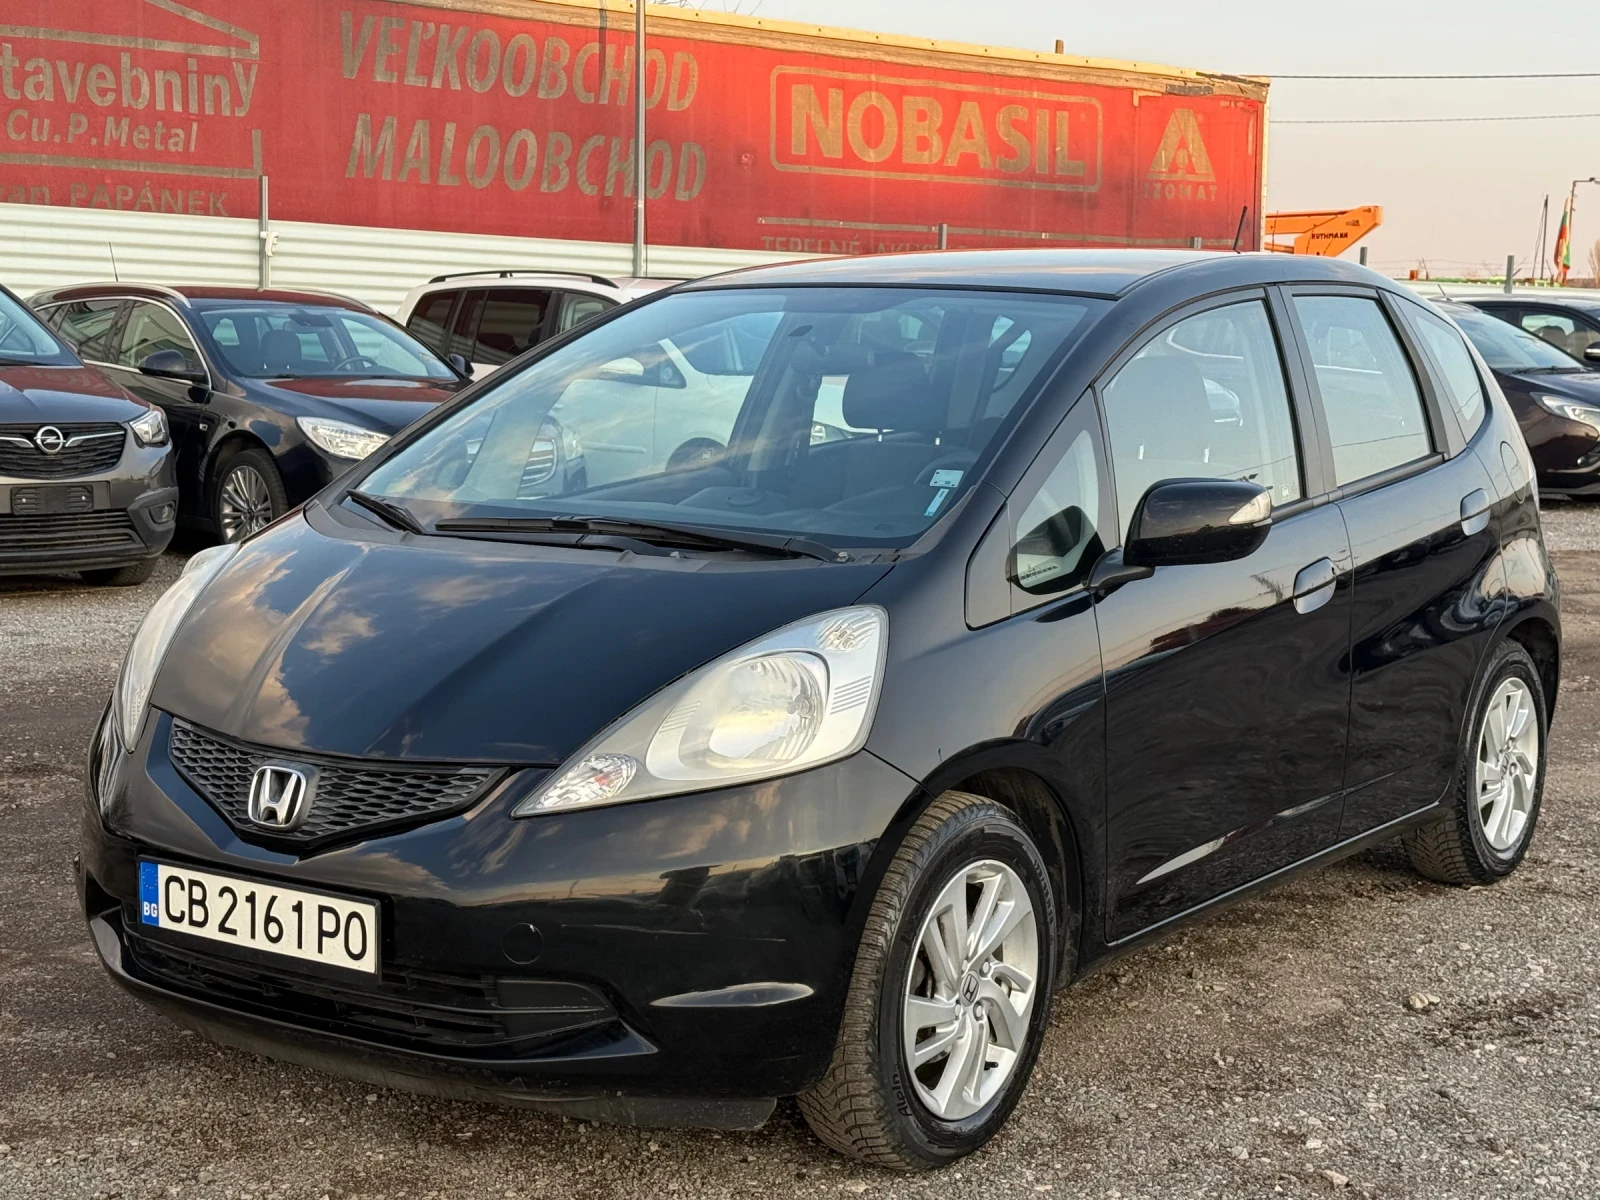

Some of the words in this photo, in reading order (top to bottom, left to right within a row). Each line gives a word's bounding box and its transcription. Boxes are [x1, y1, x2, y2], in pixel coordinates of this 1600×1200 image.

[6, 108, 199, 153] Cu.P.Metal
[791, 84, 1087, 177] NOBASIL
[345, 113, 707, 201] MALOOBCHOD
[69, 180, 229, 217] PAPÁNEK
[1143, 181, 1217, 201] IZOMAT
[1311, 232, 1349, 240] RUTHMANN
[143, 901, 158, 918] BG
